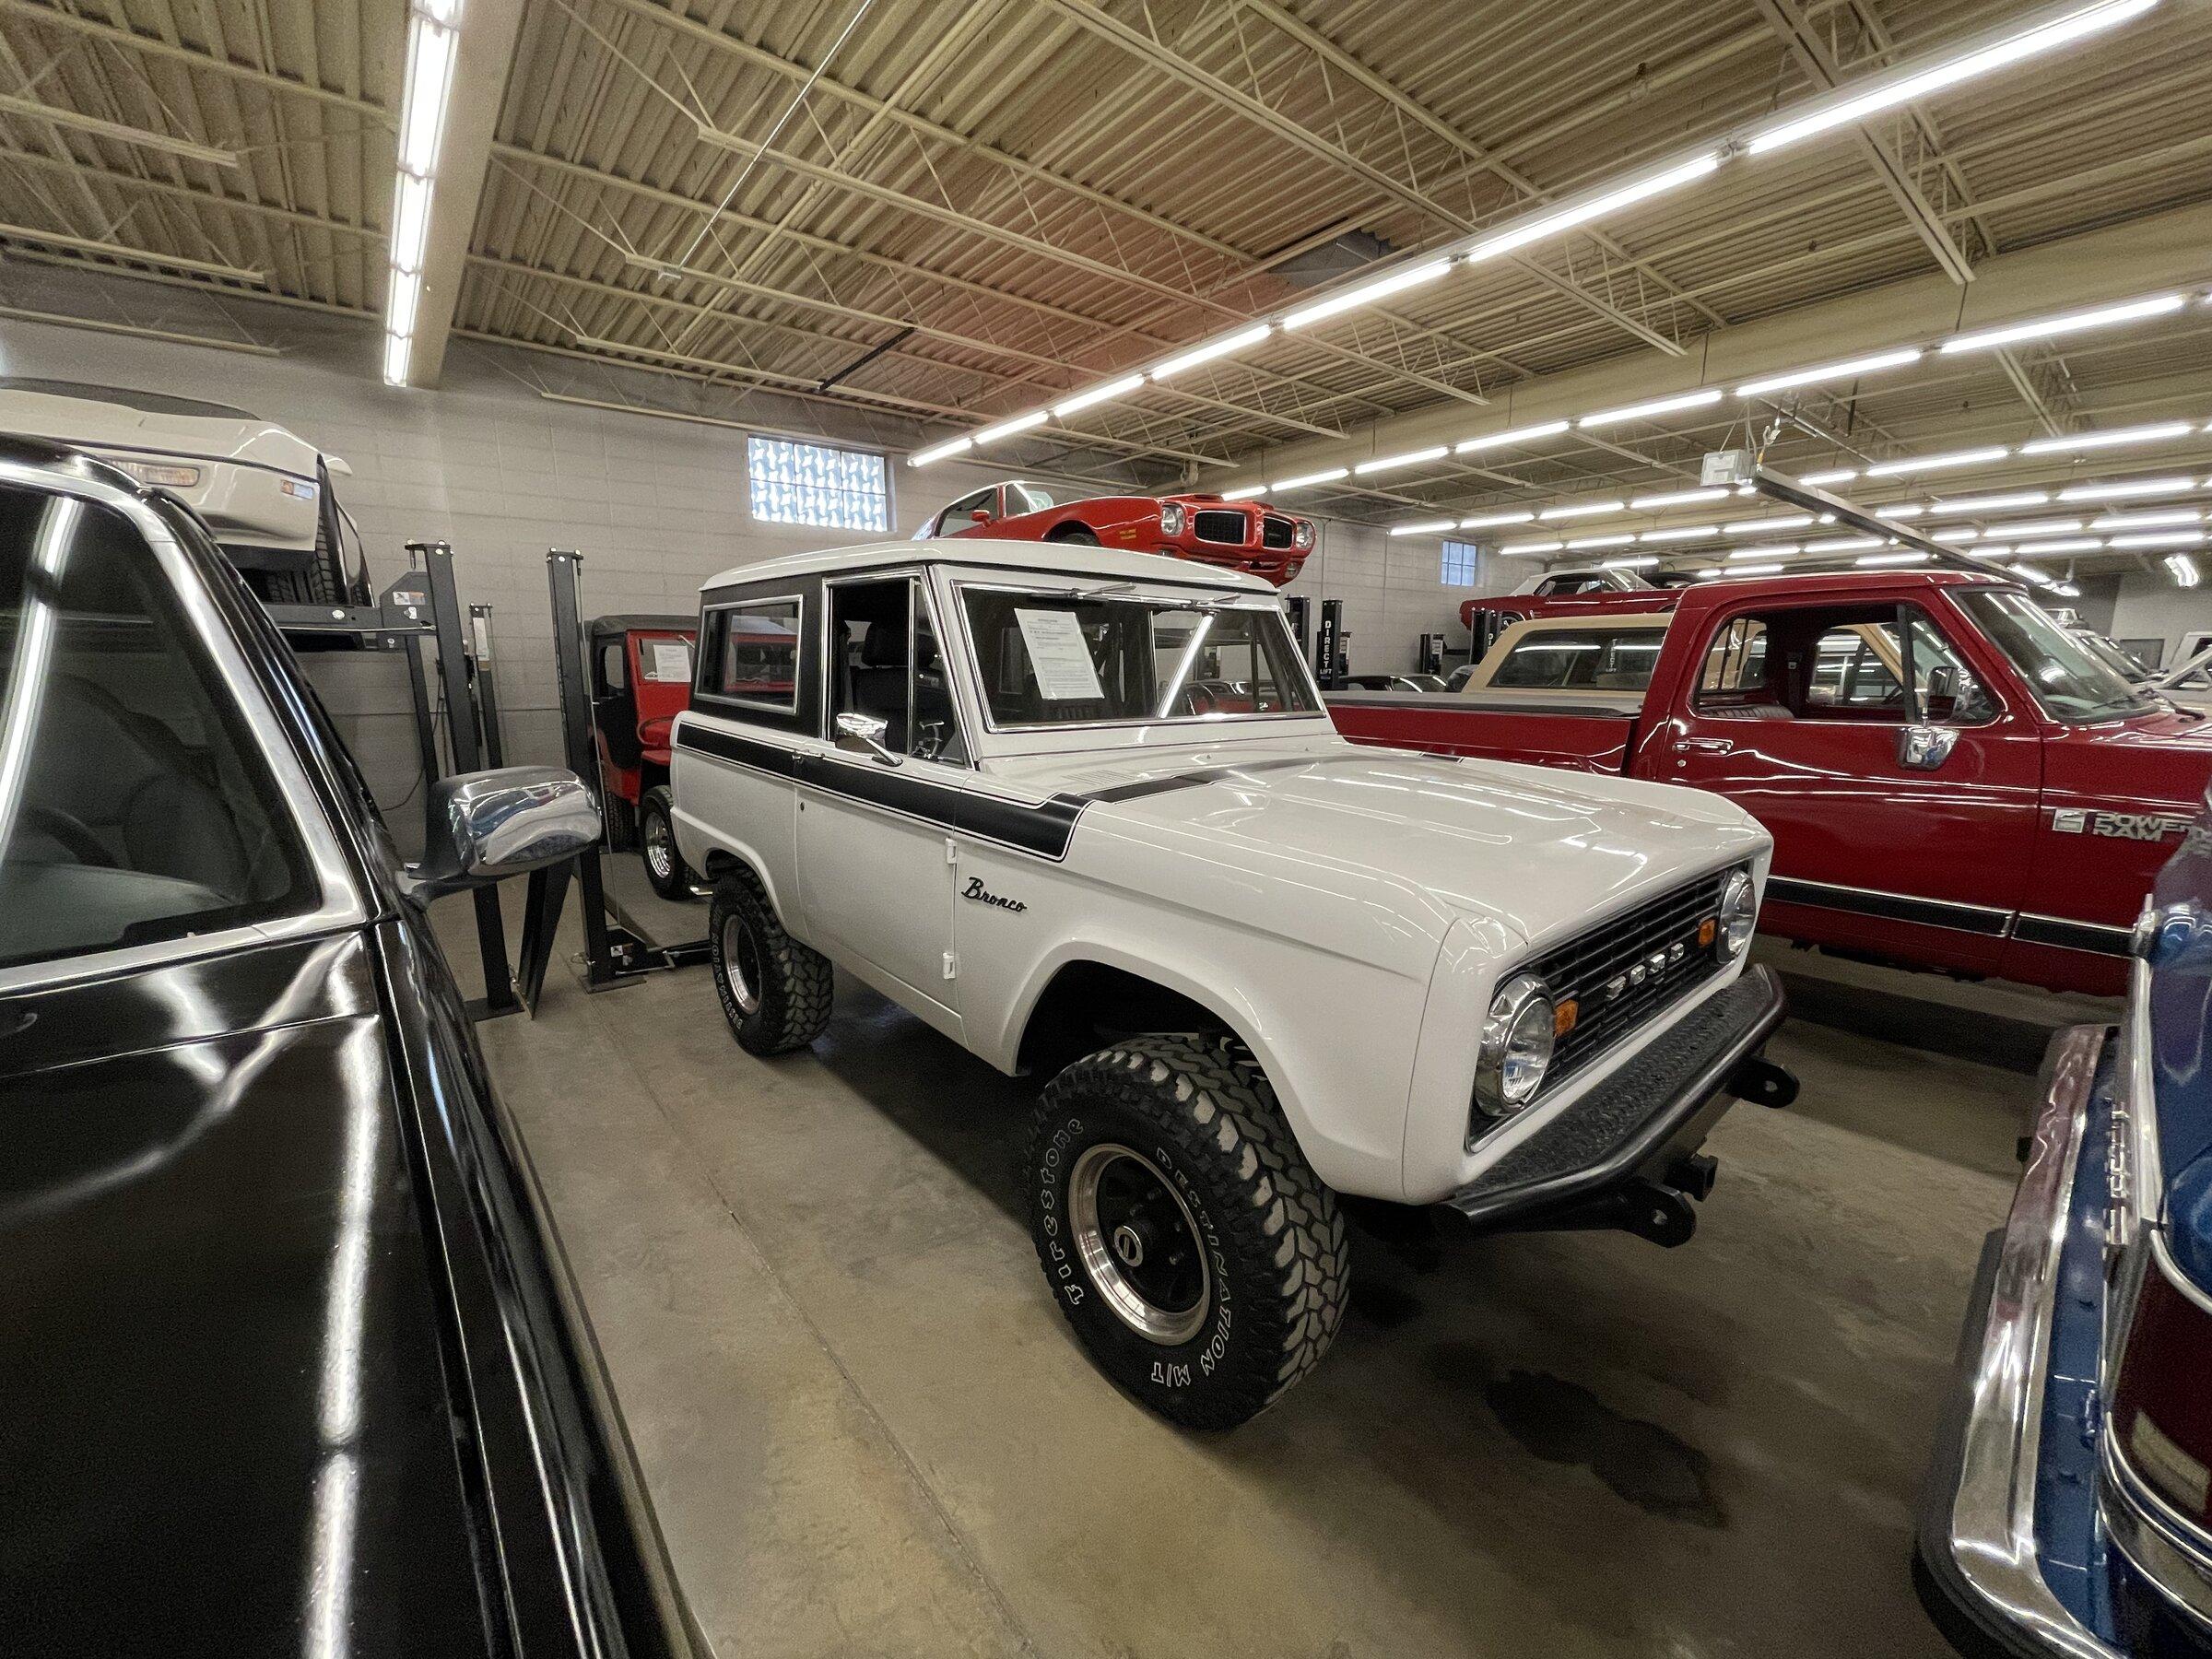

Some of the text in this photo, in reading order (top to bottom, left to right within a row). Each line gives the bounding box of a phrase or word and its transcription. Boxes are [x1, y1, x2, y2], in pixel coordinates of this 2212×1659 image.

[1323, 620, 1332, 668] DIRECT
[2092, 825, 2163, 842] RAM
[960, 876, 1028, 912] Bronco
[1606, 942, 1685, 1001] FORD
[1150, 1147, 1232, 1388] DESTINATION M/T
